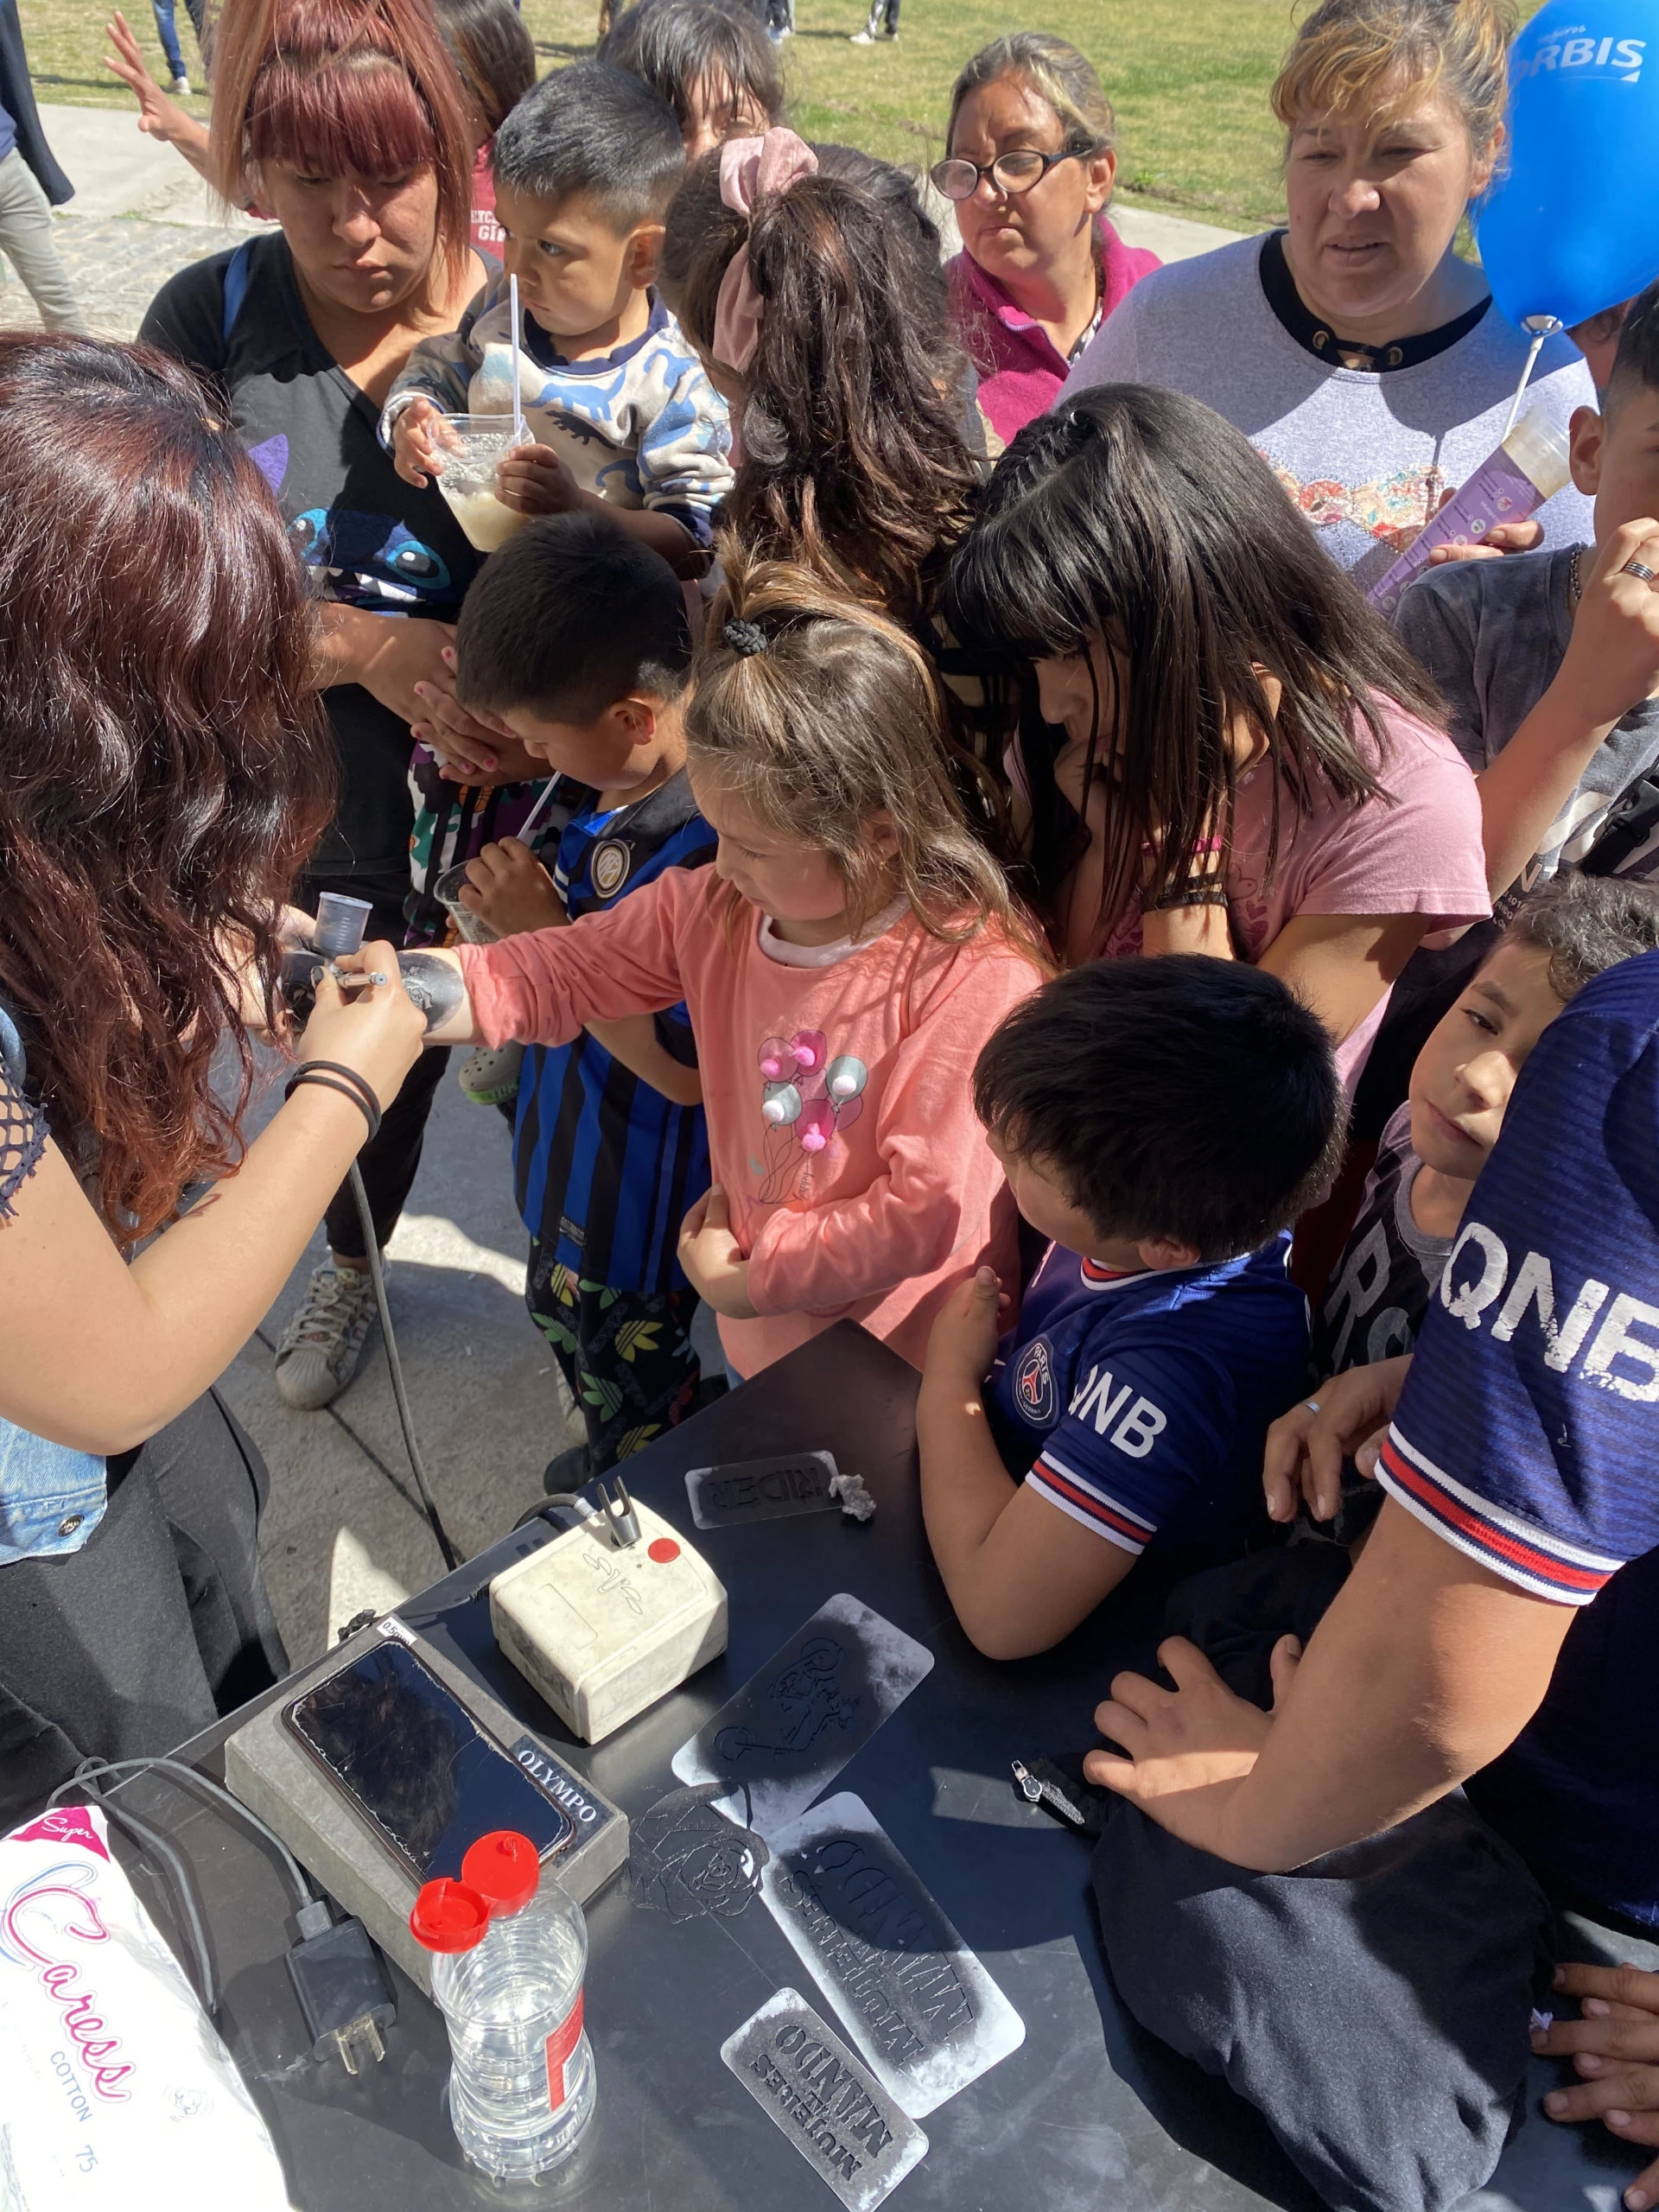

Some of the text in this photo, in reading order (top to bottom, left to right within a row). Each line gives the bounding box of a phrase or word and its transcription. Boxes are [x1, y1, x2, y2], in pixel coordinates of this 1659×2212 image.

[1440, 1221, 1659, 1402] QNB
[1034, 1345, 1052, 1385] PARIS
[708, 1467, 824, 1510] RIDER
[518, 1749, 597, 1822] OLYMPO
[41, 1816, 94, 1841] Super
[819, 1840, 975, 2041] MANDO
[4, 1885, 134, 2101] Caress
[50, 2050, 93, 2123] COTTON
[749, 2053, 863, 2181] MUJERES
[775, 2024, 893, 2159] MANDO
[75, 2144, 99, 2173] 75
